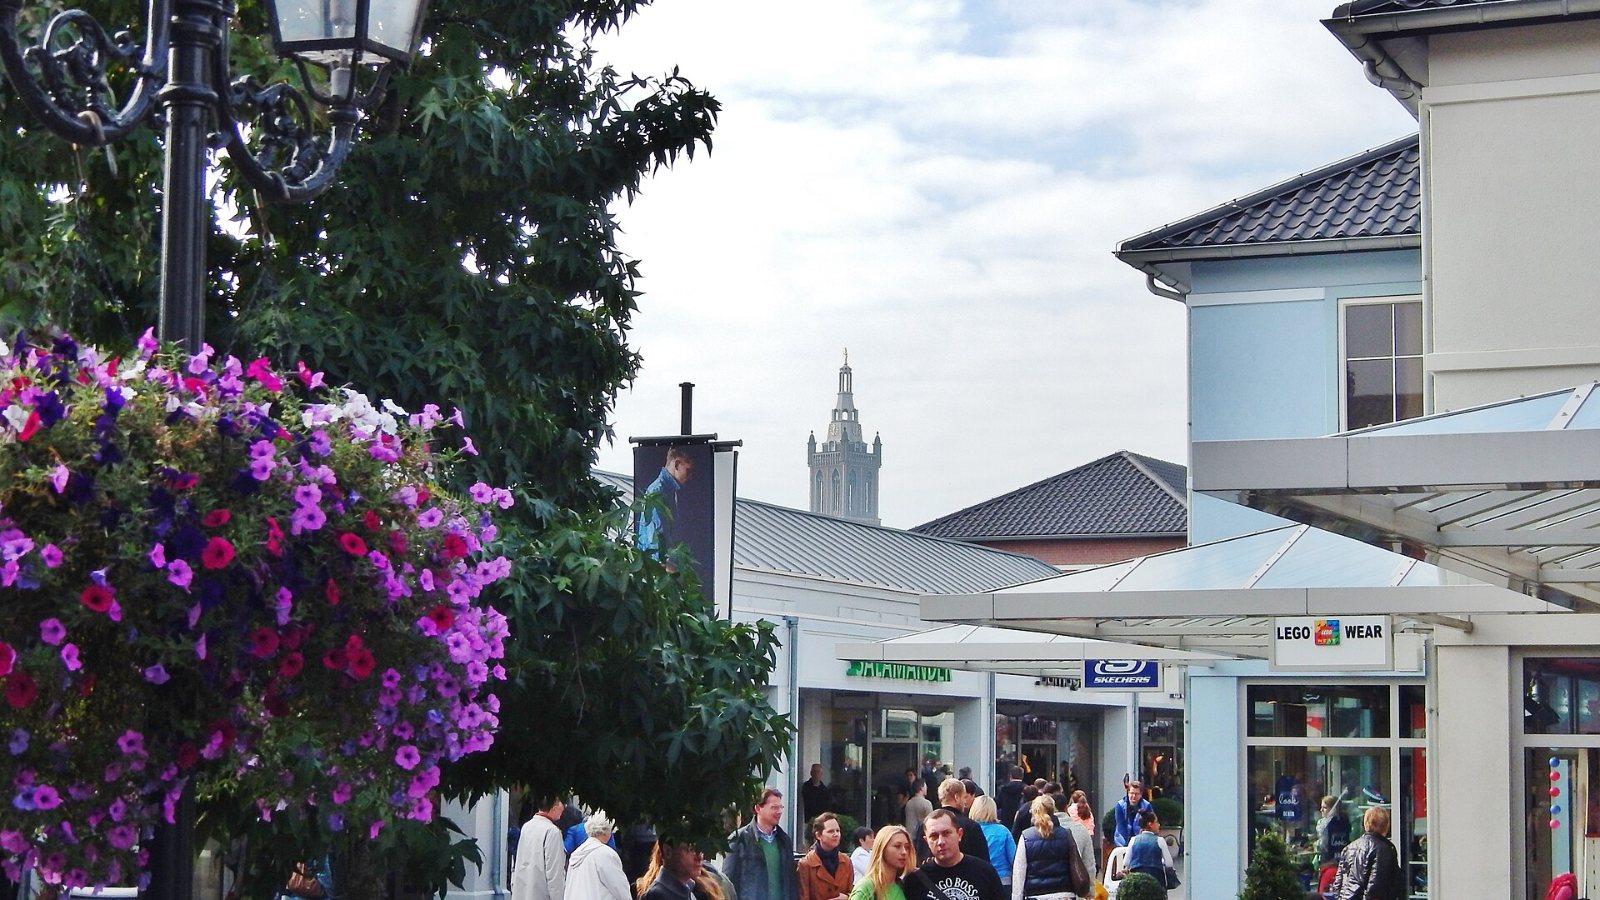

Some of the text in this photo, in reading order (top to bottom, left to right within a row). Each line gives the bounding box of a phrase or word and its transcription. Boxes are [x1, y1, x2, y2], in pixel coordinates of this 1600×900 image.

[1277, 624, 1383, 640] LEGO WEAR
[1093, 676, 1151, 684] SKECHERS
[953, 877, 979, 897] BOSS
